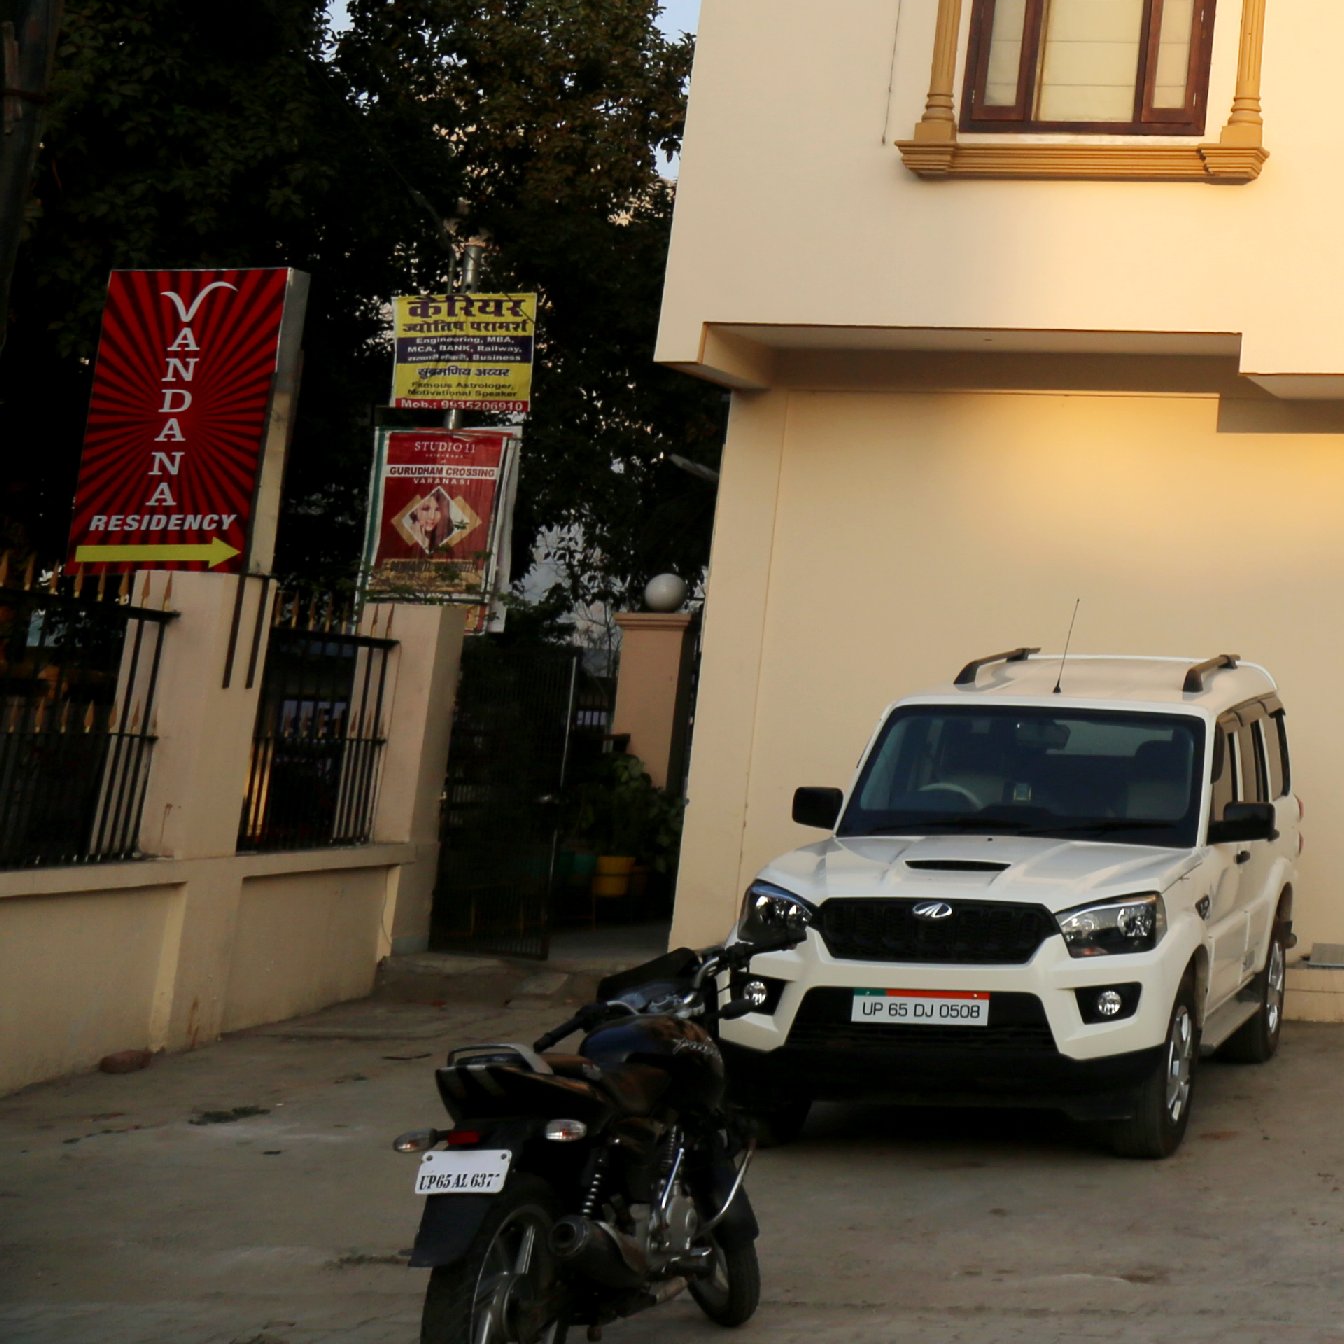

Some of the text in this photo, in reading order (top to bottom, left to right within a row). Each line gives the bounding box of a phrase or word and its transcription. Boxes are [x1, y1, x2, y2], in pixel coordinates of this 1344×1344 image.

[439, 345, 474, 353] BANK,
[145, 281, 238, 506] VANDANA
[475, 389, 517, 398] Speaker
[414, 441, 463, 452] STUDIO
[389, 466, 495, 478] GURUDHAM CROSSING
[89, 514, 237, 531] RESIDENCY
[862, 1002, 981, 1018] UP 65 DJ 0508
[452, 1173, 468, 1188] AL
